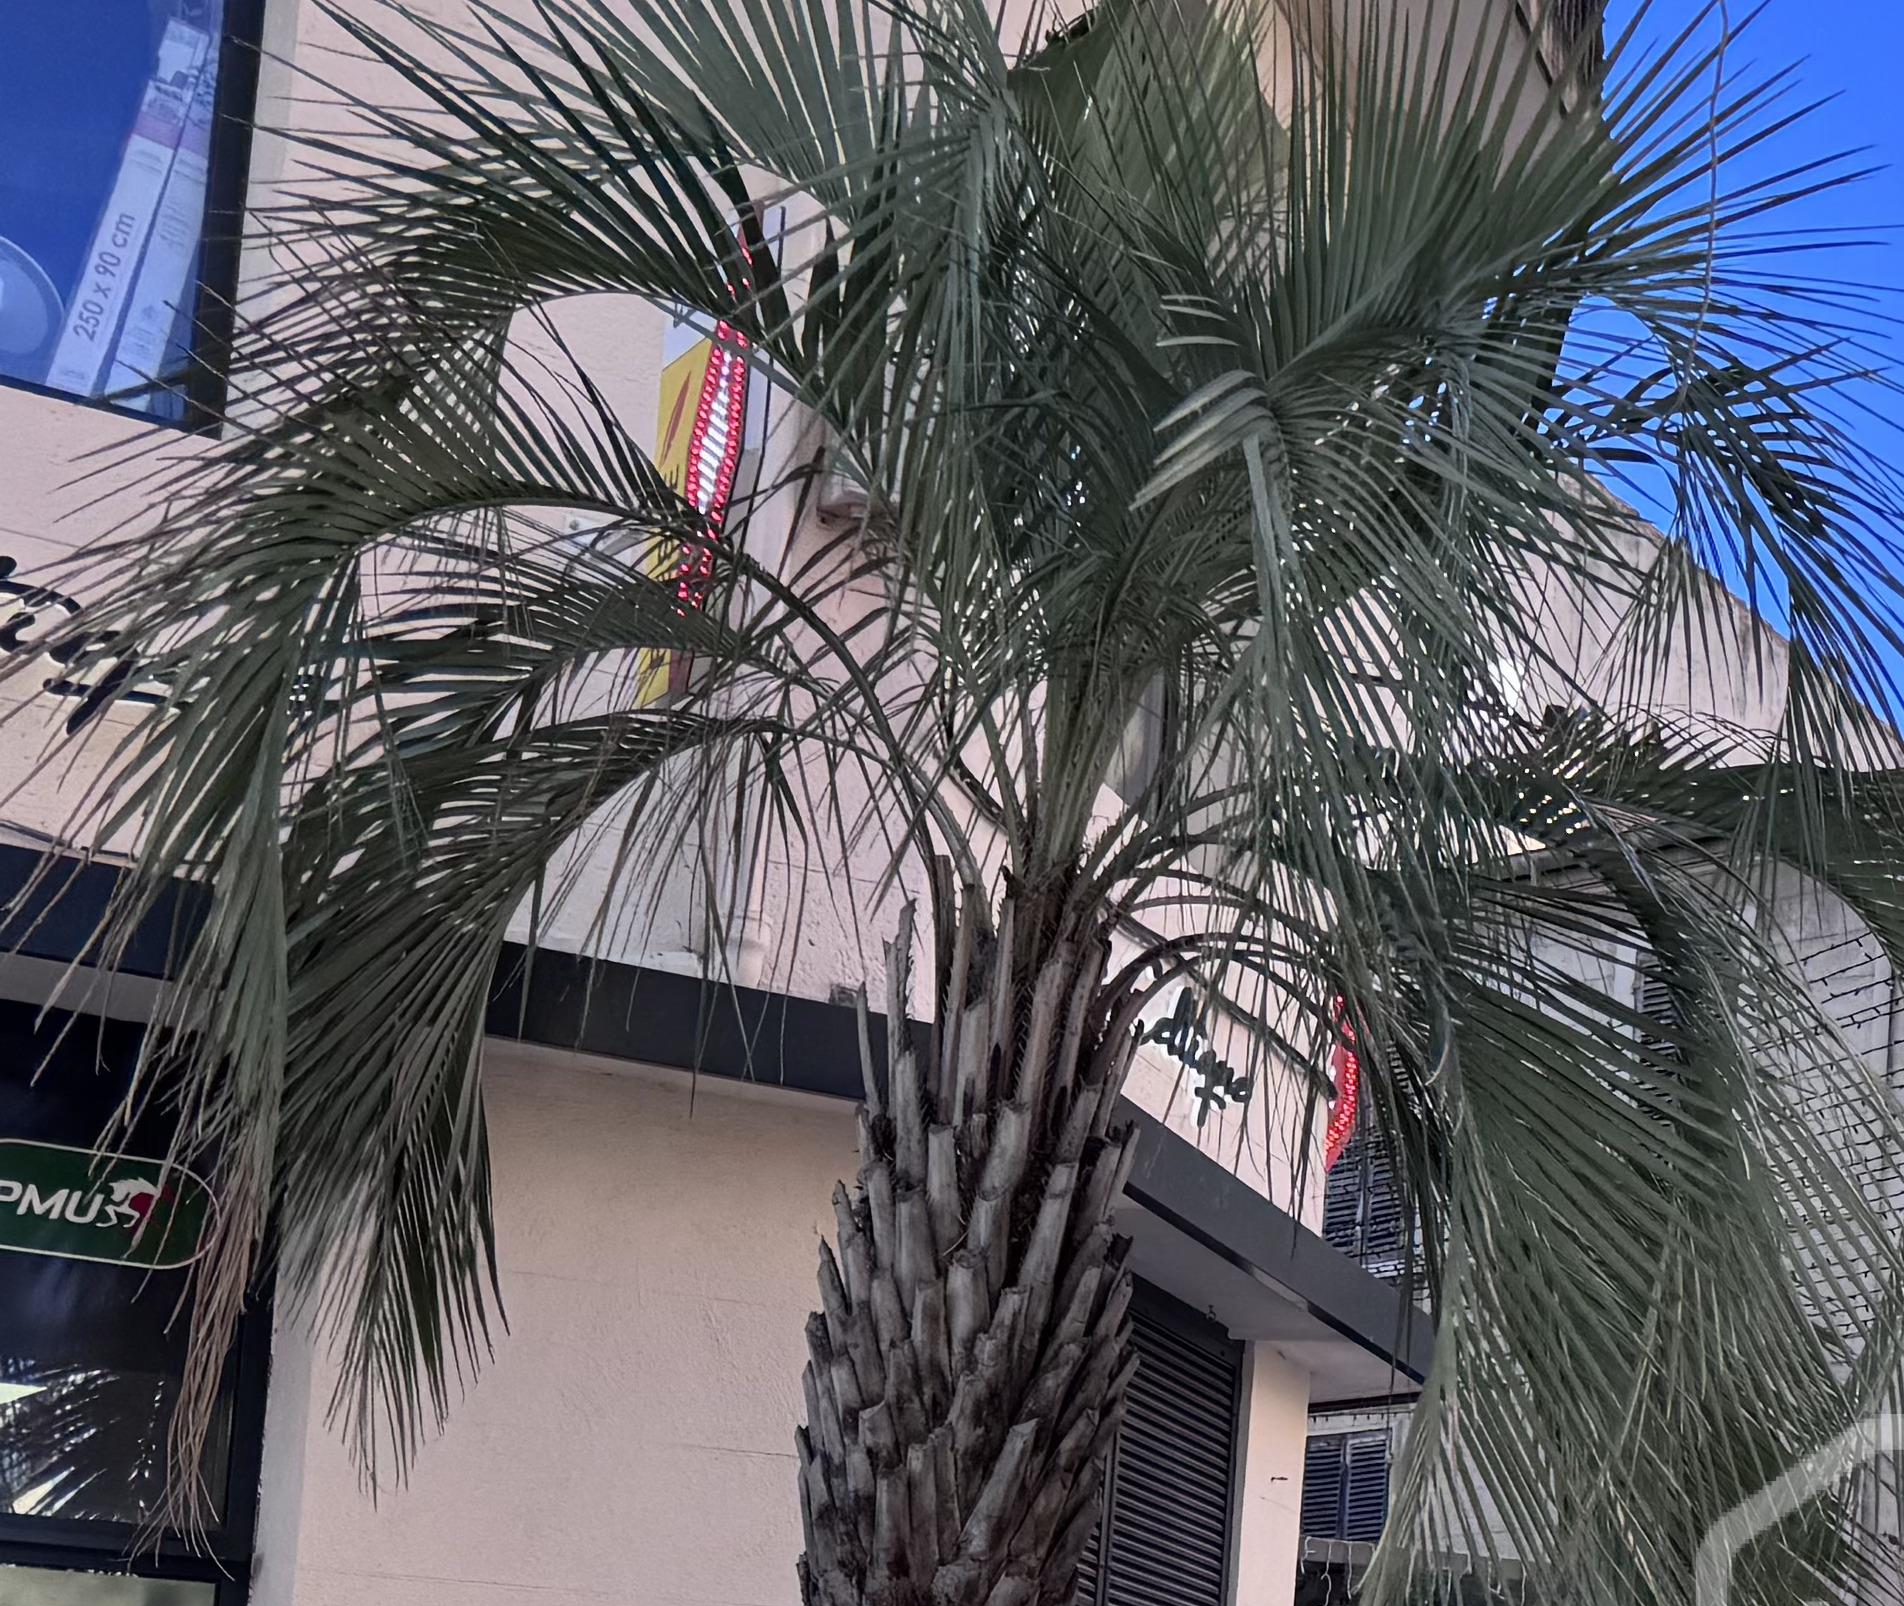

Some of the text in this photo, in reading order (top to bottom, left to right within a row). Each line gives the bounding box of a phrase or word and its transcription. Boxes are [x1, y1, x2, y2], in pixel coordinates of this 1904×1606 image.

[73, 300, 104, 342] 250
[94, 252, 121, 279] 90
[112, 213, 136, 249] cm
